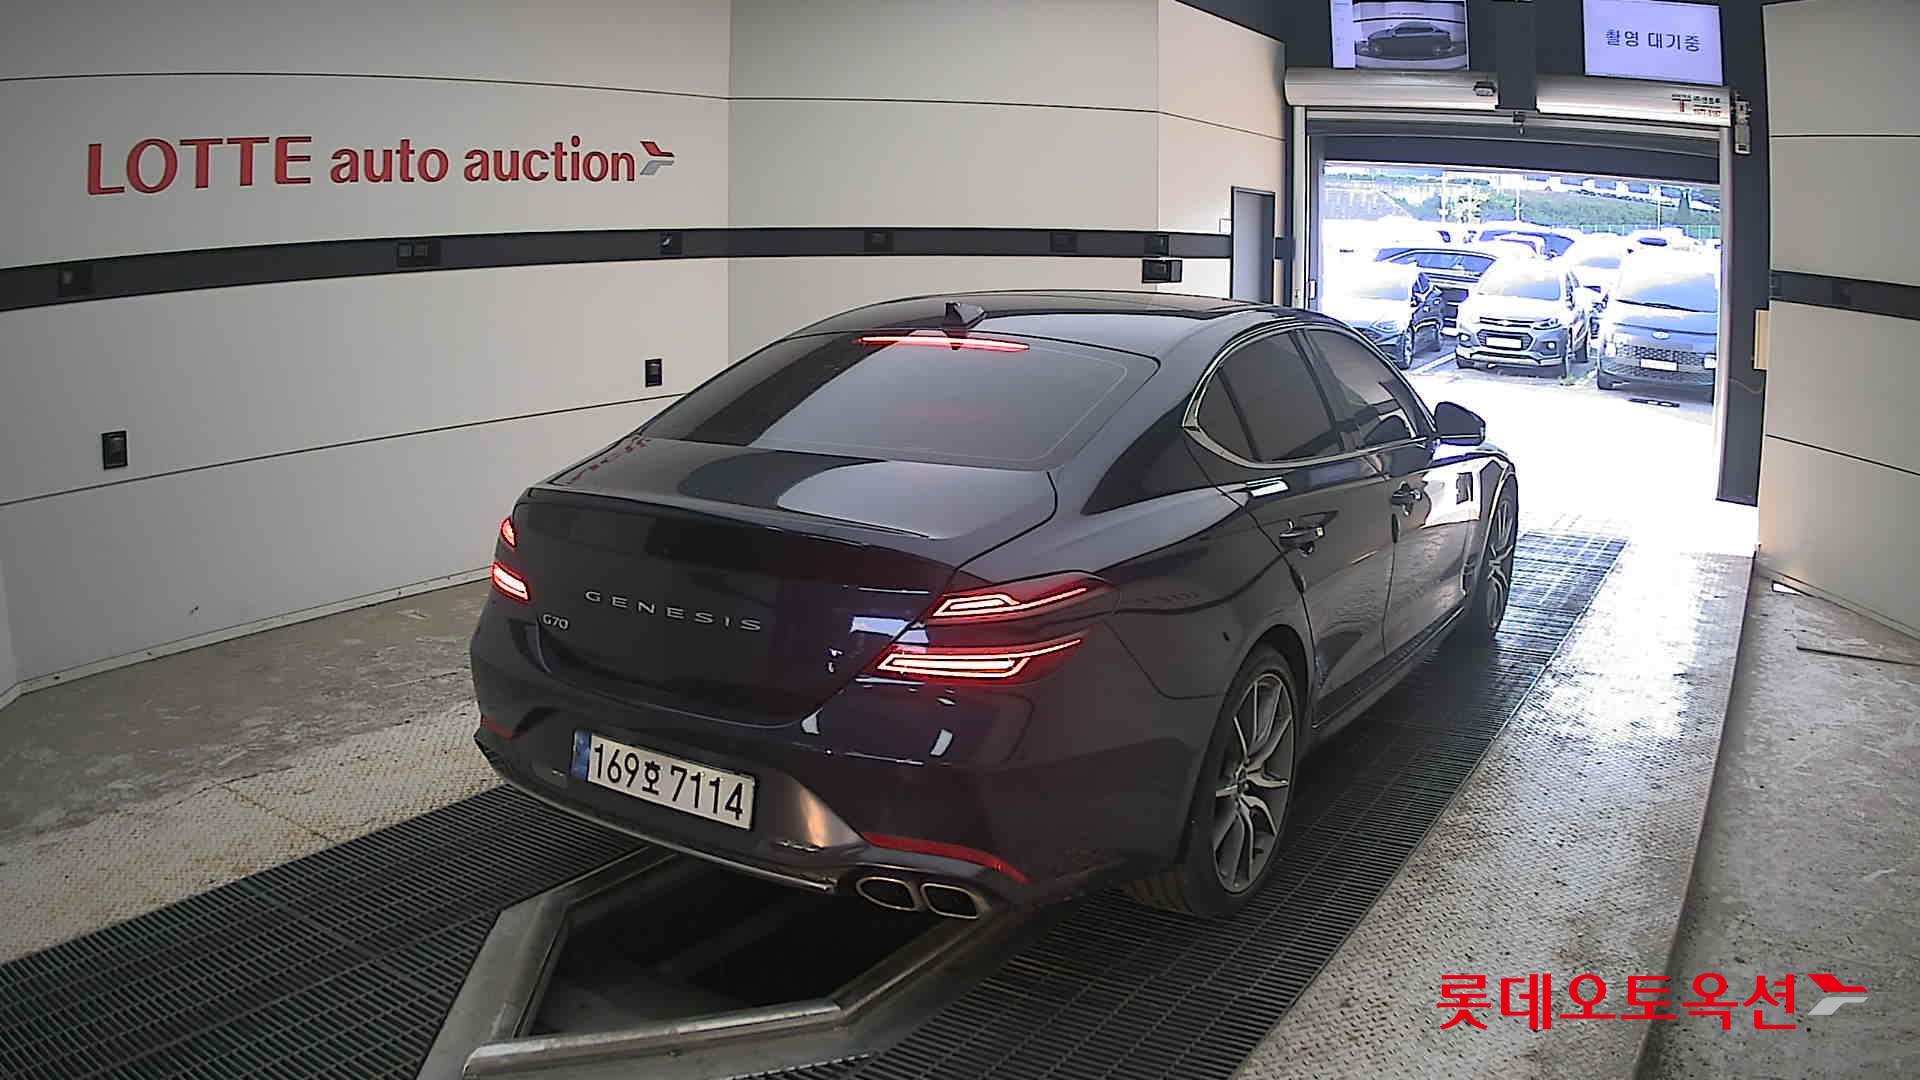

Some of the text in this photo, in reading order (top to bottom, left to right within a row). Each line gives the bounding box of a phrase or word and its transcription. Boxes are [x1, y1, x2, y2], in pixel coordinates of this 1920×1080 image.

[1647, 32, 1701, 52] 대기중
[87, 135, 636, 195] LOTTE auto auction
[542, 613, 569, 630] G70
[585, 590, 761, 631] GENESIS
[594, 743, 744, 820] 169호 7114
